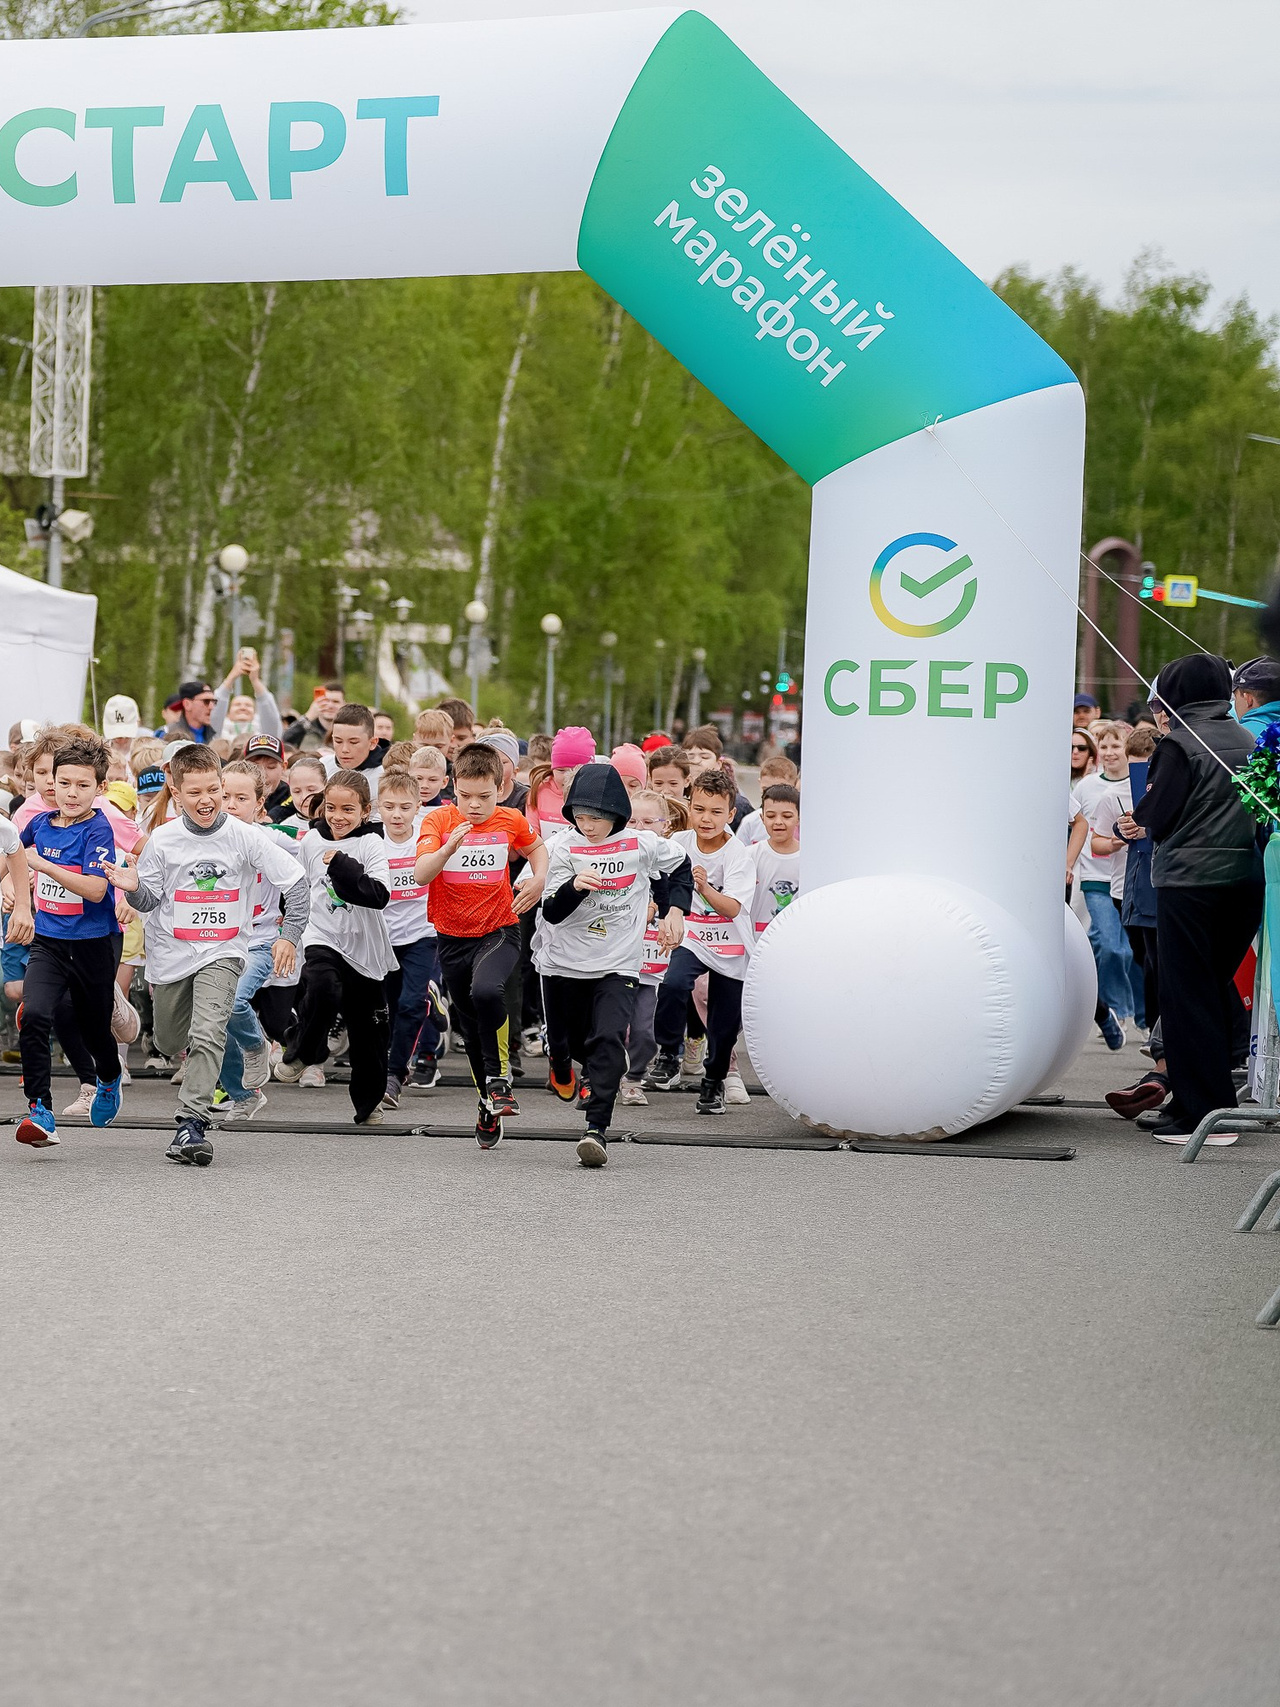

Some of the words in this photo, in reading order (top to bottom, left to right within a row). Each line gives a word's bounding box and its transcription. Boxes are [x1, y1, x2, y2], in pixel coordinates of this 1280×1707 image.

[689, 164, 896, 352] зелёный
[653, 199, 847, 388] марафон
[823, 659, 1029, 719] СБЕР
[138, 772, 167, 787] NEVE
[95, 846, 109, 861] 7
[461, 854, 495, 867] 2663
[394, 875, 416, 887] 288
[41, 882, 66, 899] 2772
[192, 912, 227, 925] 2758
[699, 931, 729, 942] 2814
